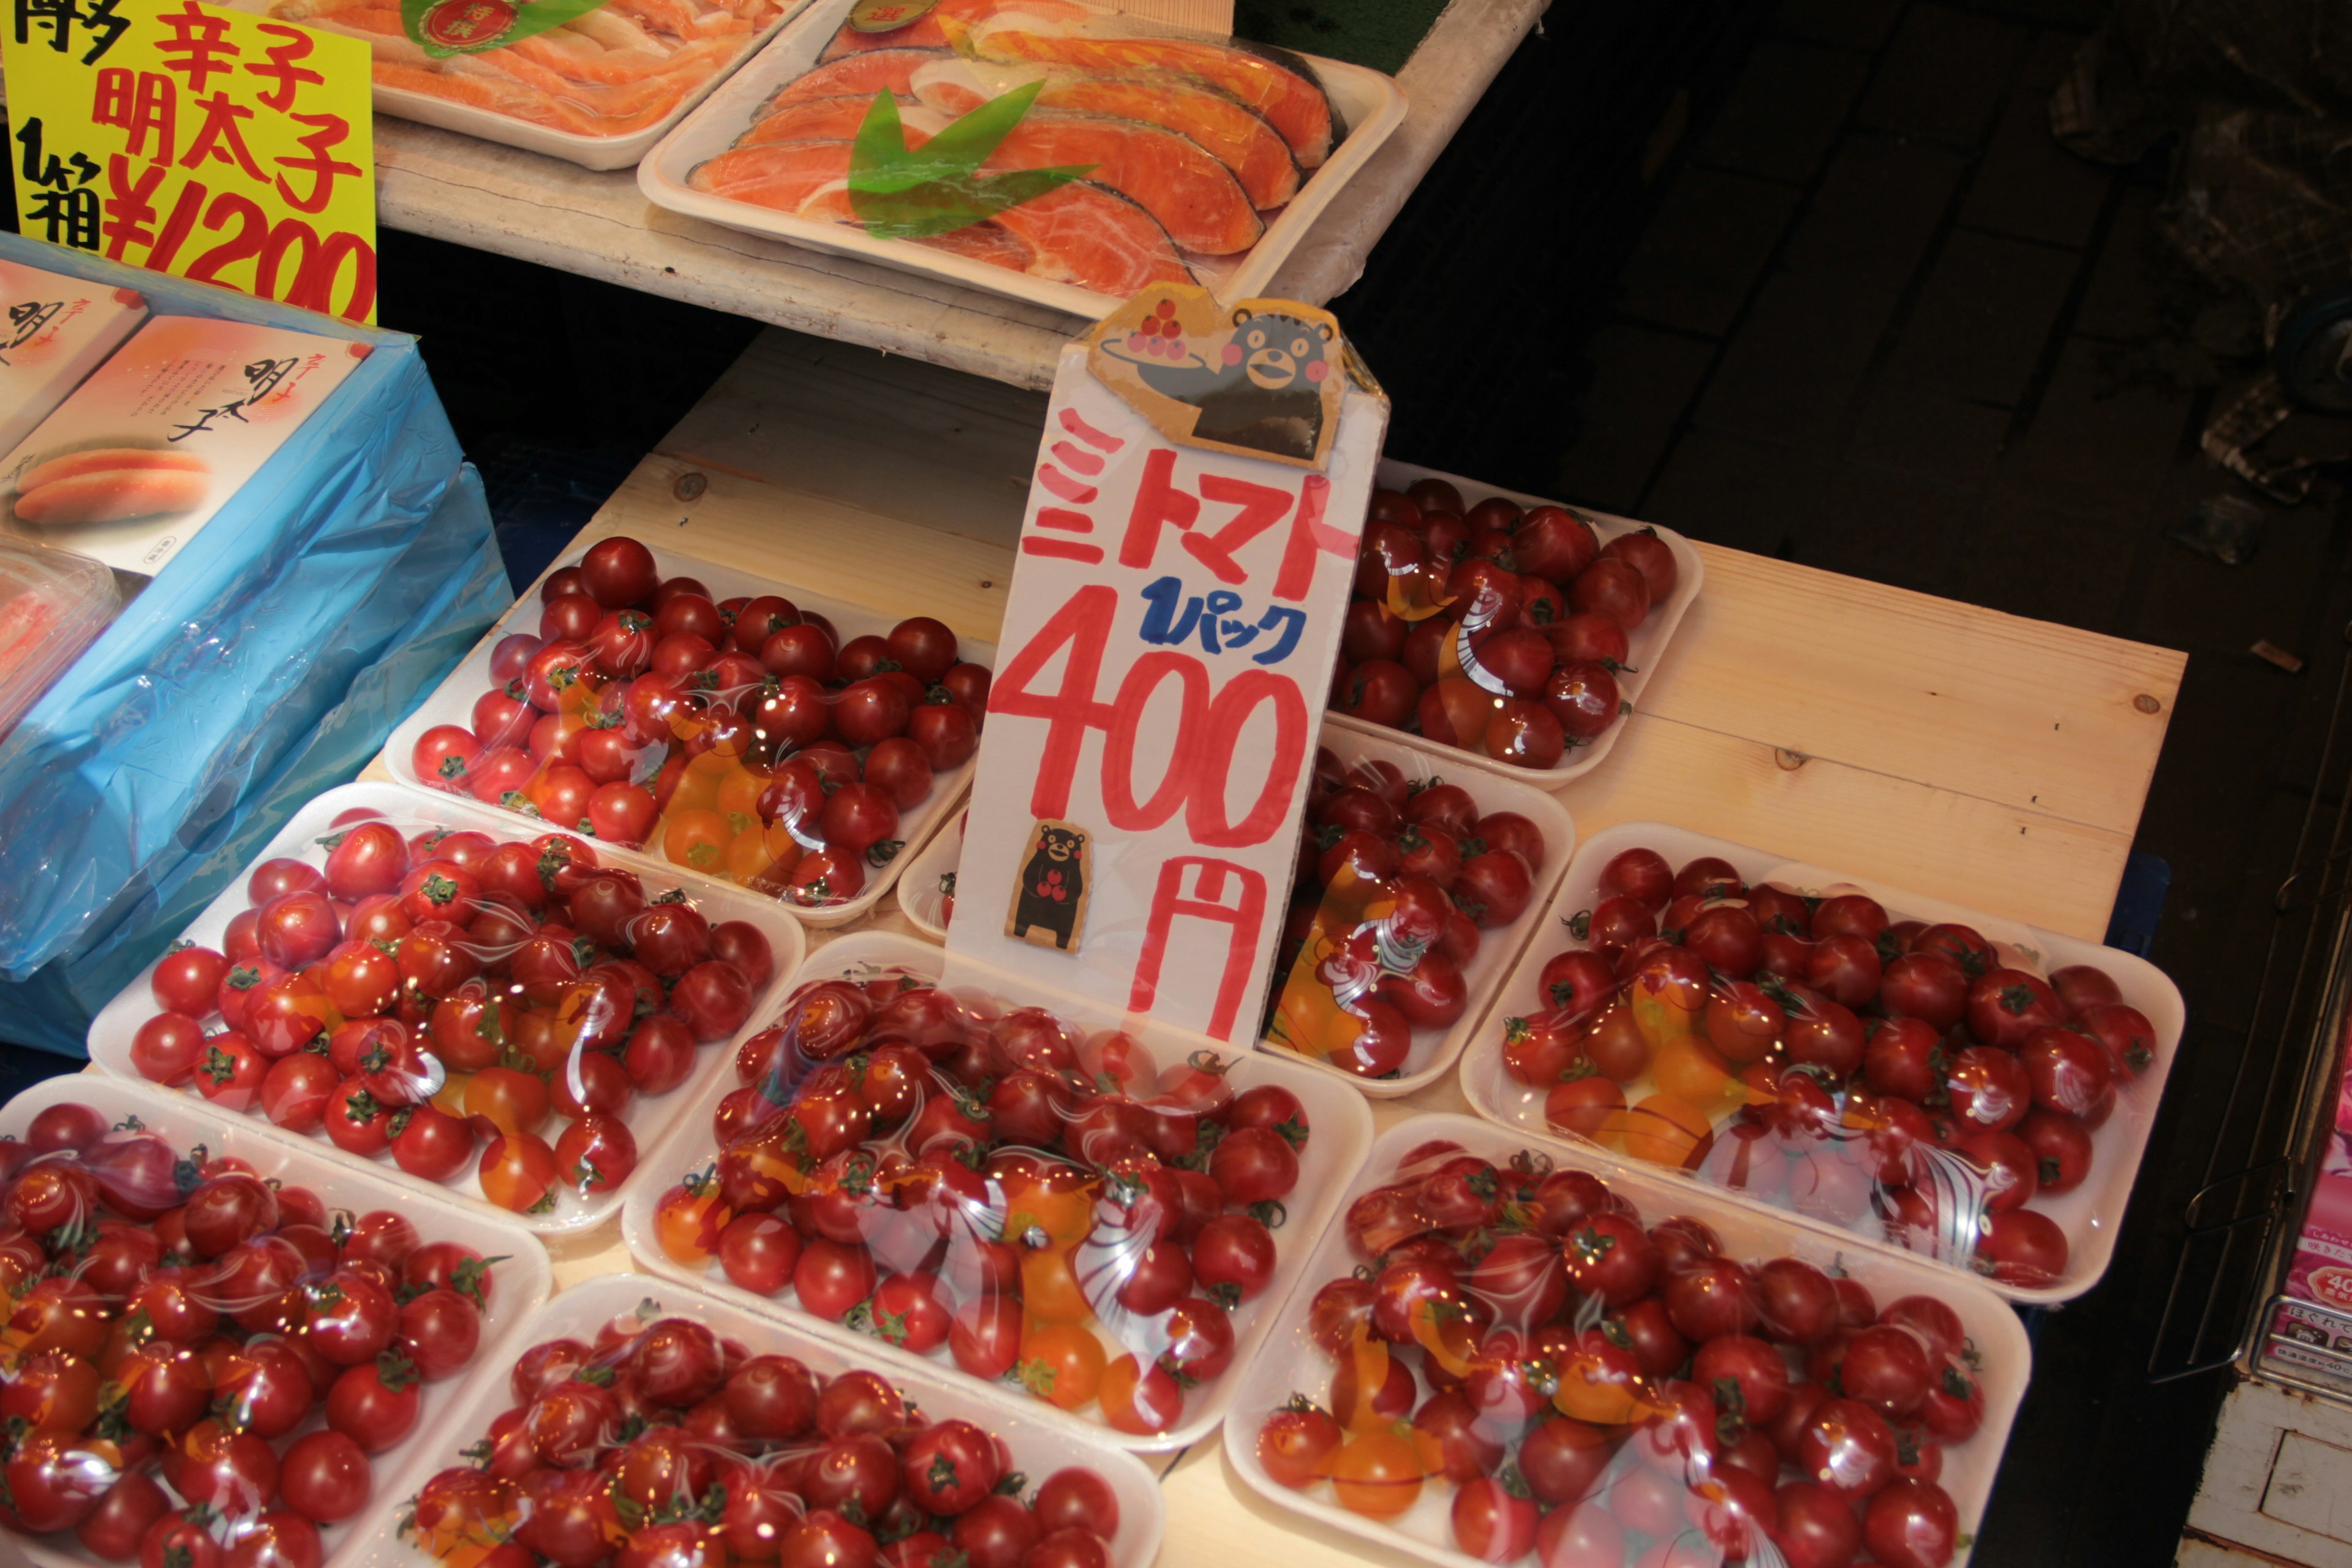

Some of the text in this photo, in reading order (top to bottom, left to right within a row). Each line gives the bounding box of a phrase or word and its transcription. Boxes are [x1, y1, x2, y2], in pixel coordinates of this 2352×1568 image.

[154, 0, 325, 114] 辛子
[92, 67, 363, 214] 明太子
[102, 153, 376, 325] ¥1200
[1140, 576, 1307, 665] 1パック
[987, 584, 1308, 848] 400
[1121, 856, 1267, 1042] 円
